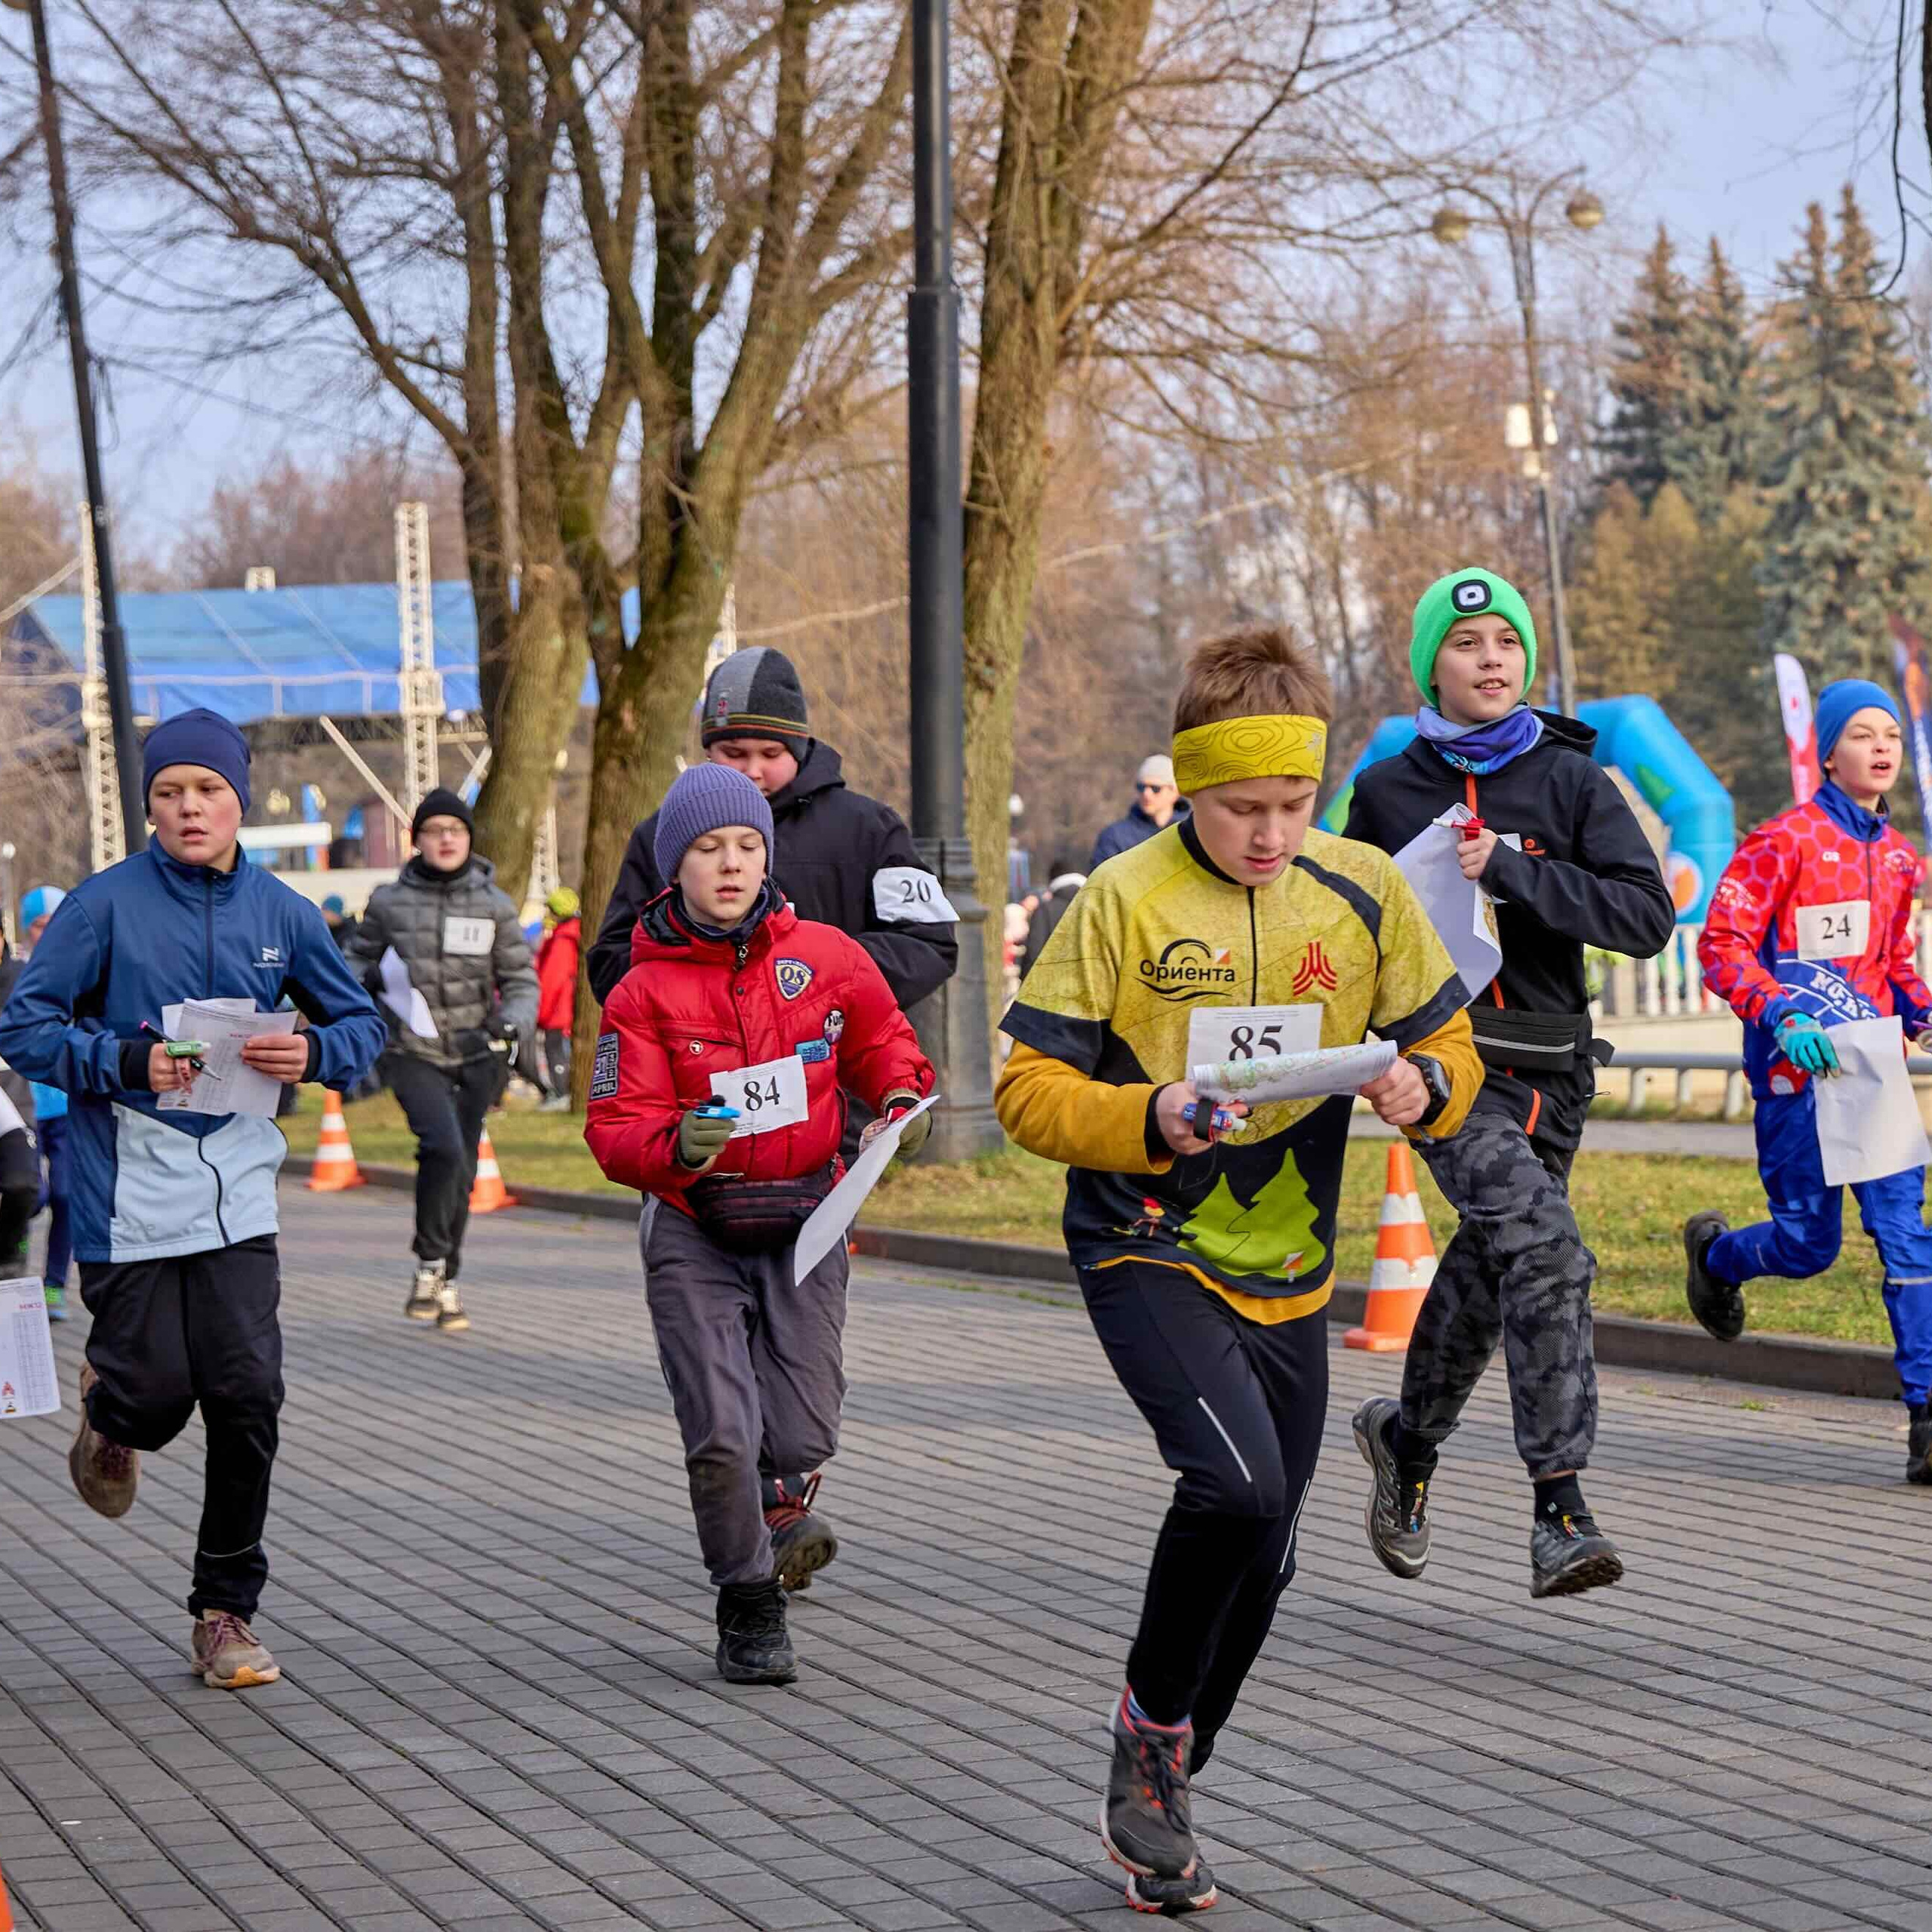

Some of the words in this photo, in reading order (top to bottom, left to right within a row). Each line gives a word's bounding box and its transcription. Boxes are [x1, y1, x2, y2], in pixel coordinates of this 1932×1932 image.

[900, 879, 931, 903] 20
[1821, 914, 1852, 940] 24
[1140, 958, 1235, 982] Ориента
[1229, 1025, 1283, 1061] 85
[743, 1075, 780, 1111] 84
